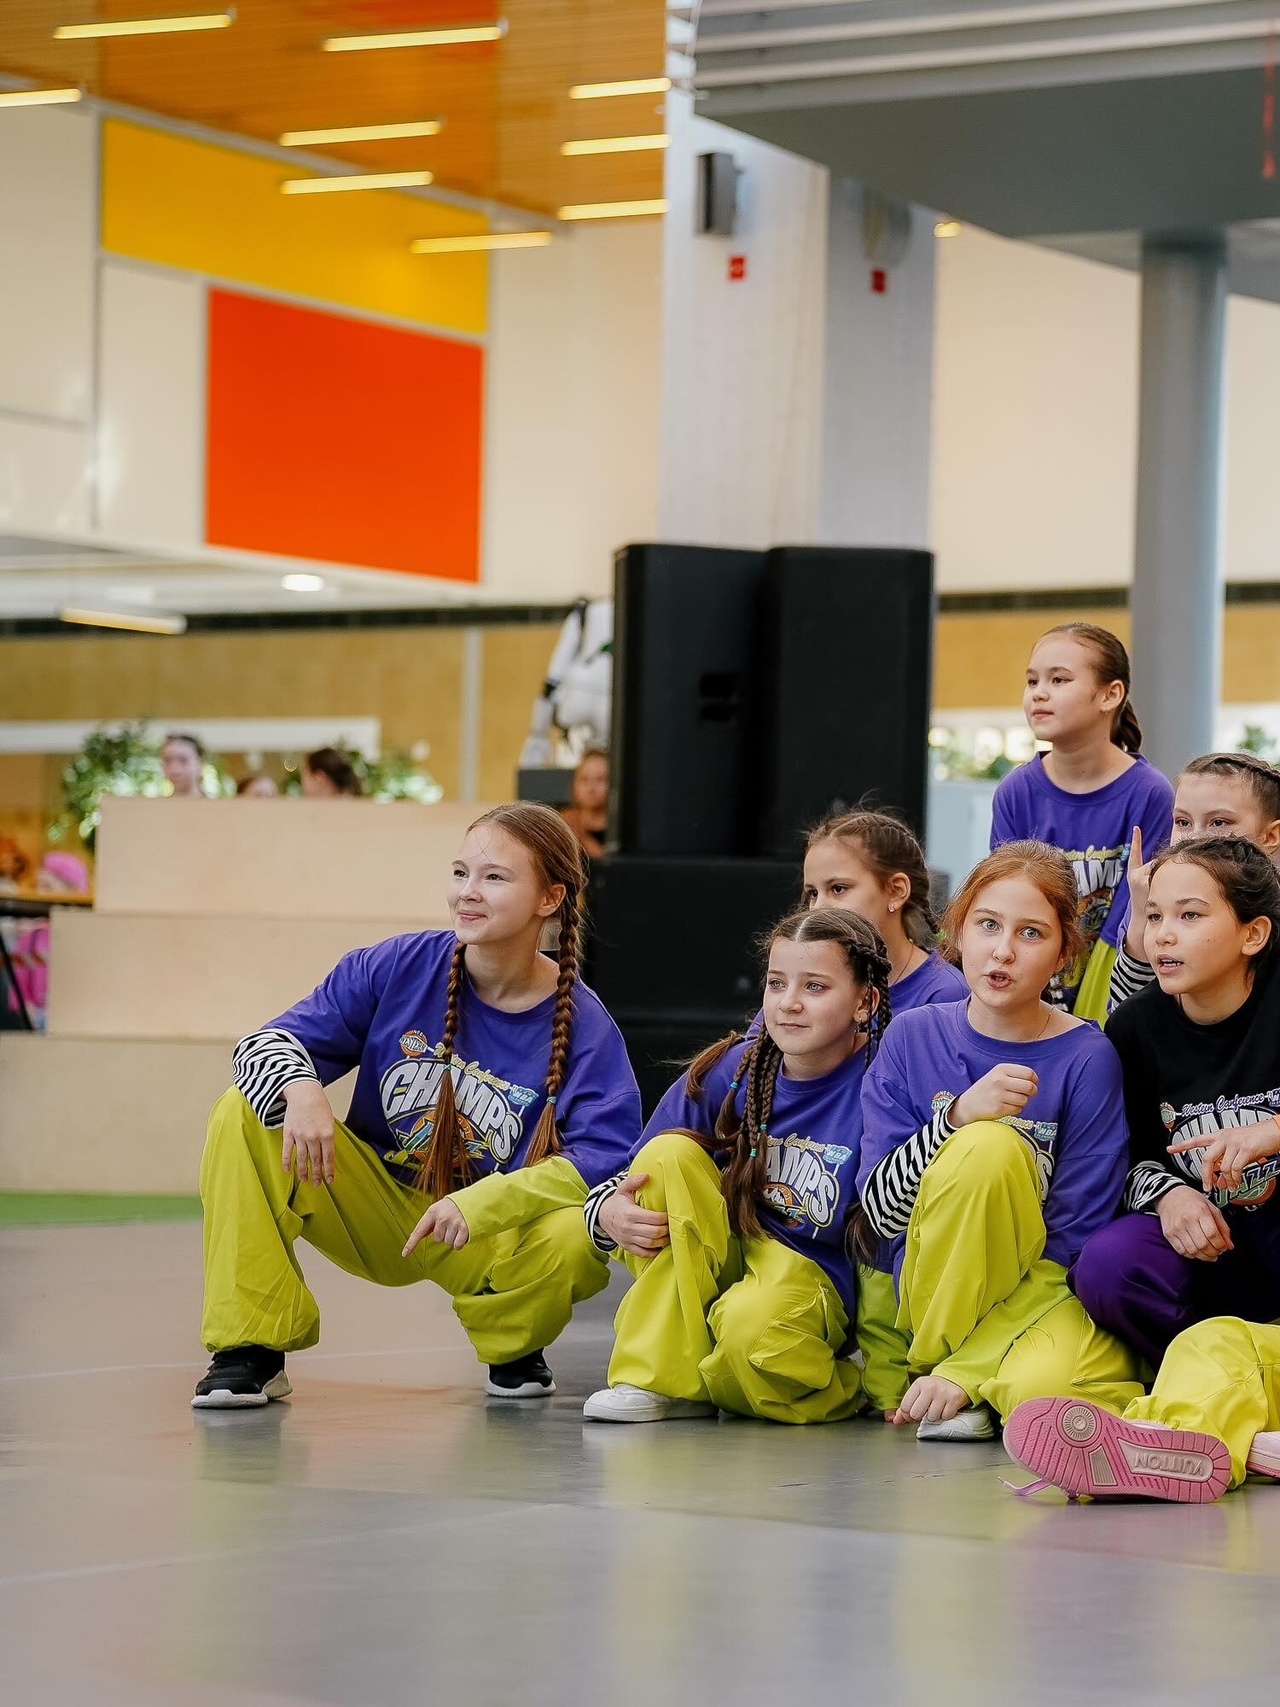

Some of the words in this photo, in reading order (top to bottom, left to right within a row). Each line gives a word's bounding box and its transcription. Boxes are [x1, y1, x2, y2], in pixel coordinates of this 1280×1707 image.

[1216, 1093, 1265, 1112] Conference
[766, 1145, 836, 1223] AMPS
[1133, 1451, 1204, 1477] VUITTON
